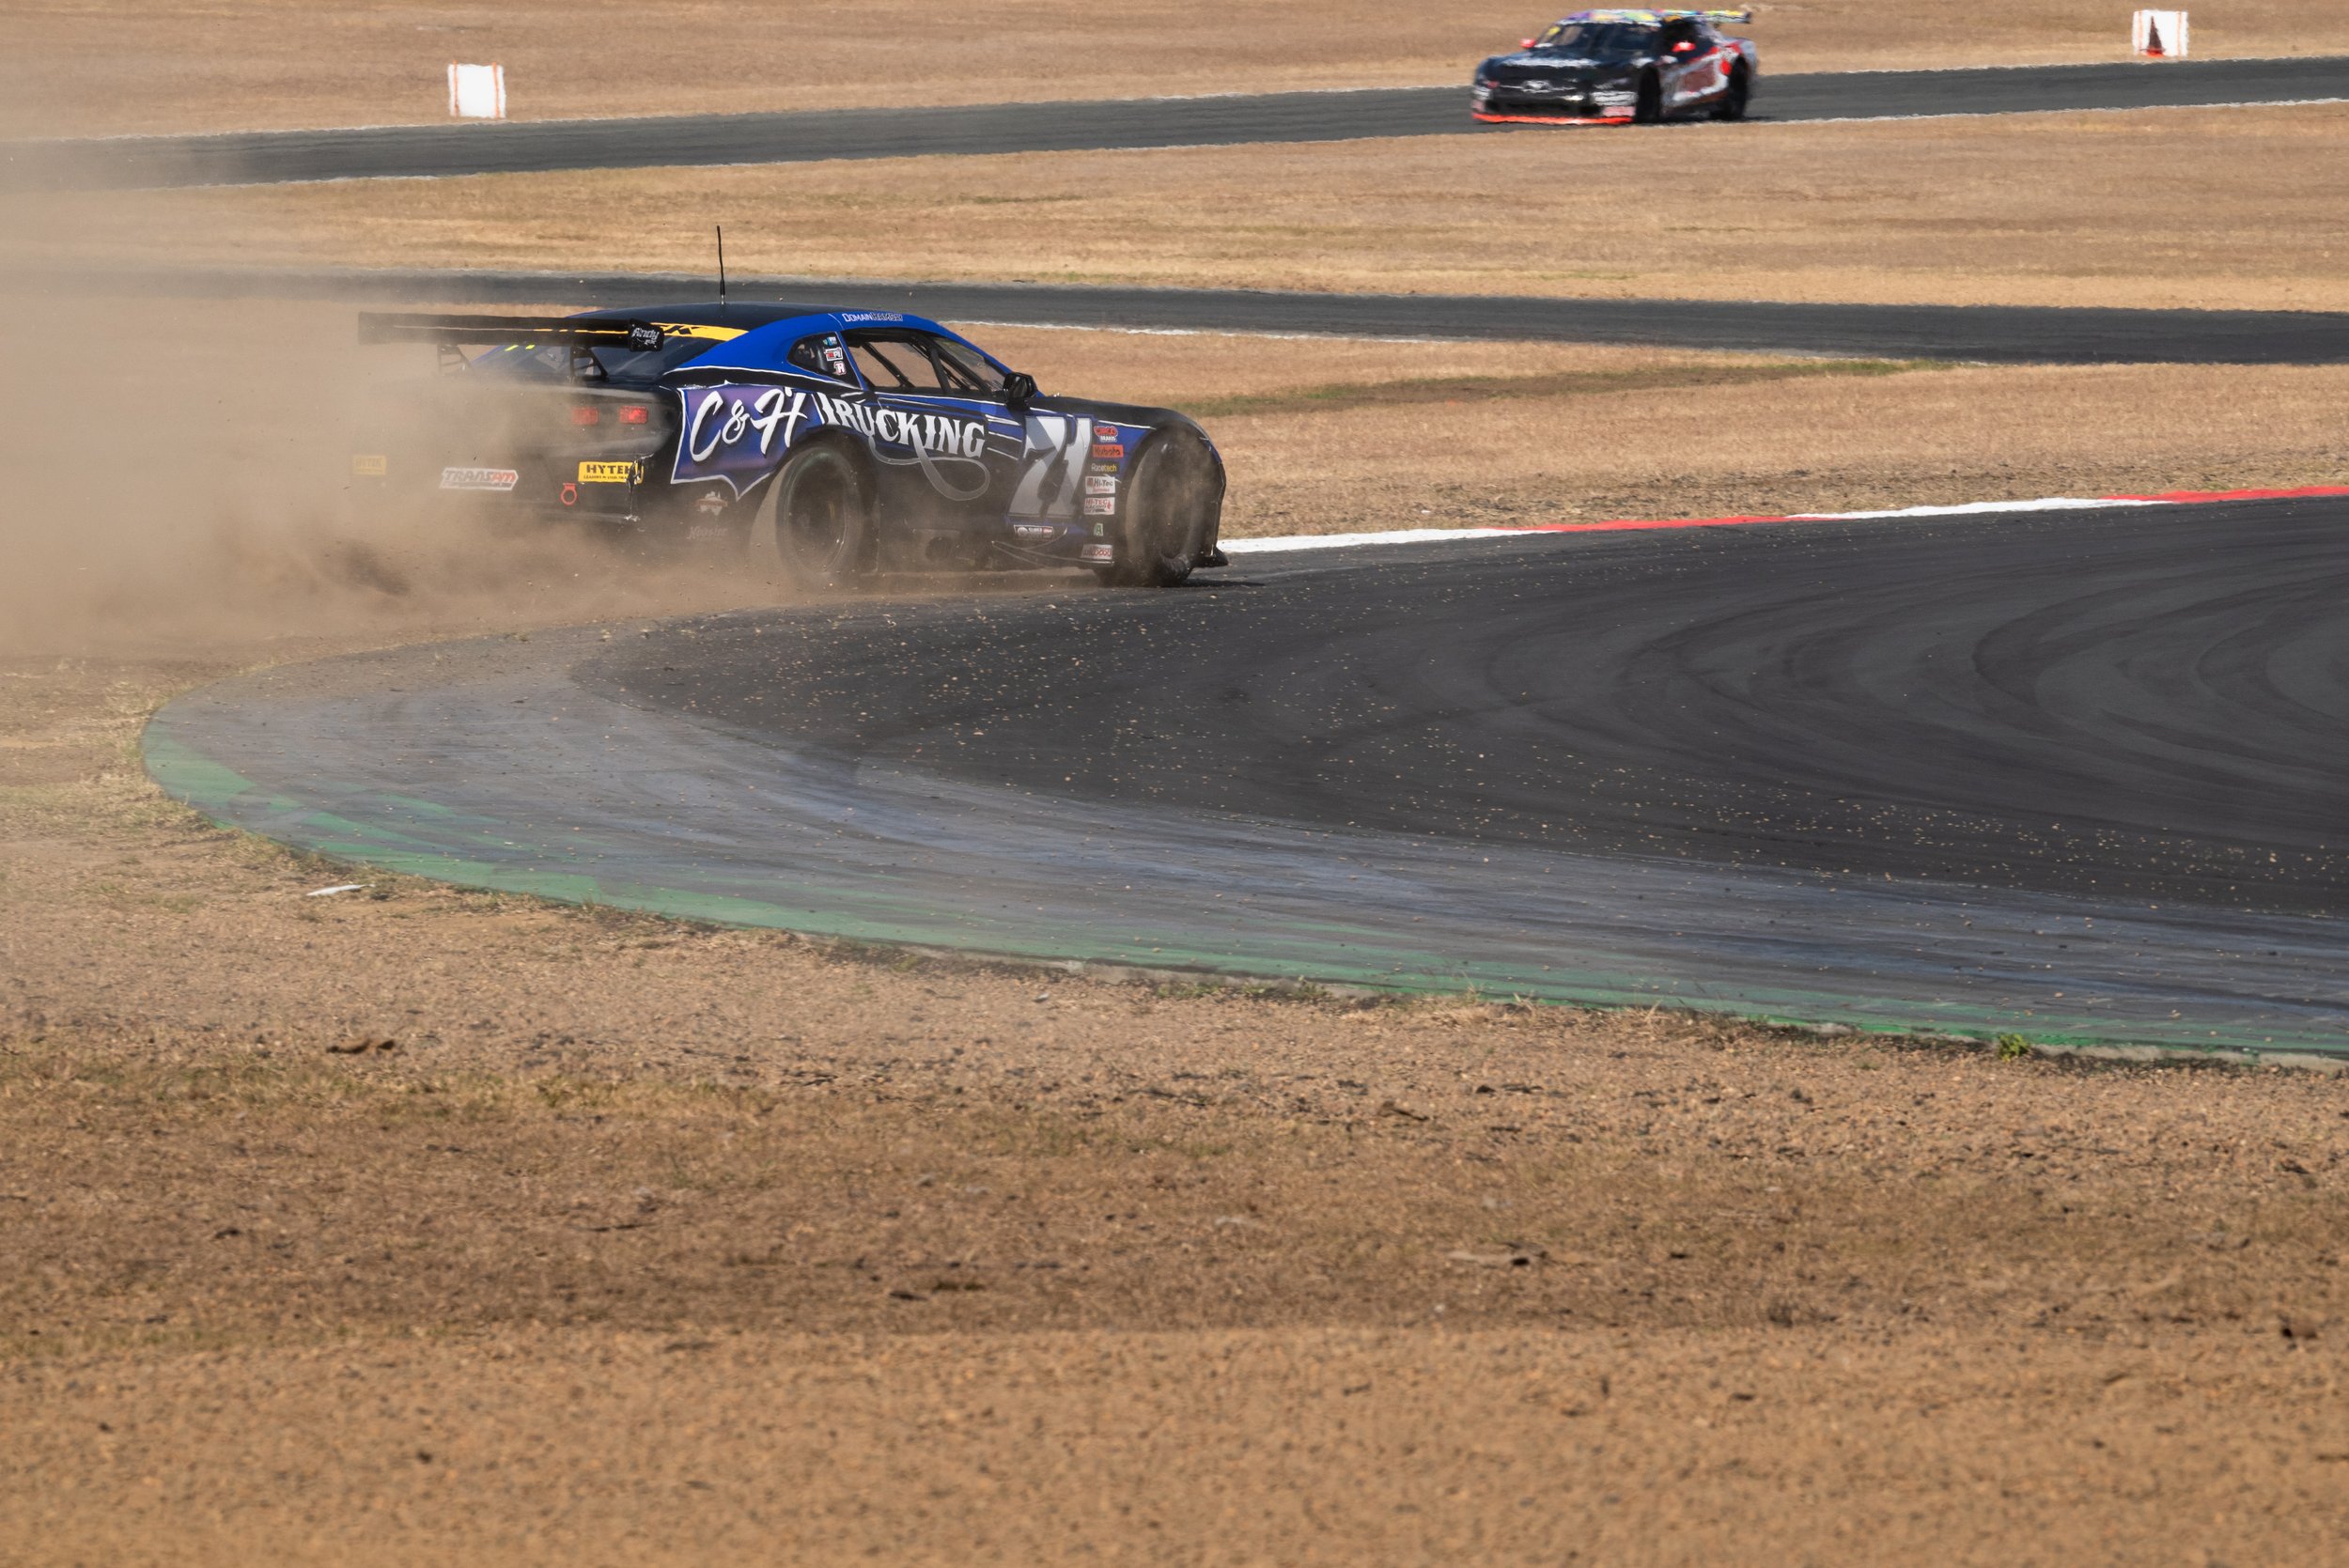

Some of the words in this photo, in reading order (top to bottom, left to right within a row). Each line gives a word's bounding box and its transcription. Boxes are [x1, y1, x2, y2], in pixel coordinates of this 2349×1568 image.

[1094, 445, 1121, 457] Kubota
[1007, 416, 1091, 518] 71
[1091, 462, 1117, 473] Racetech
